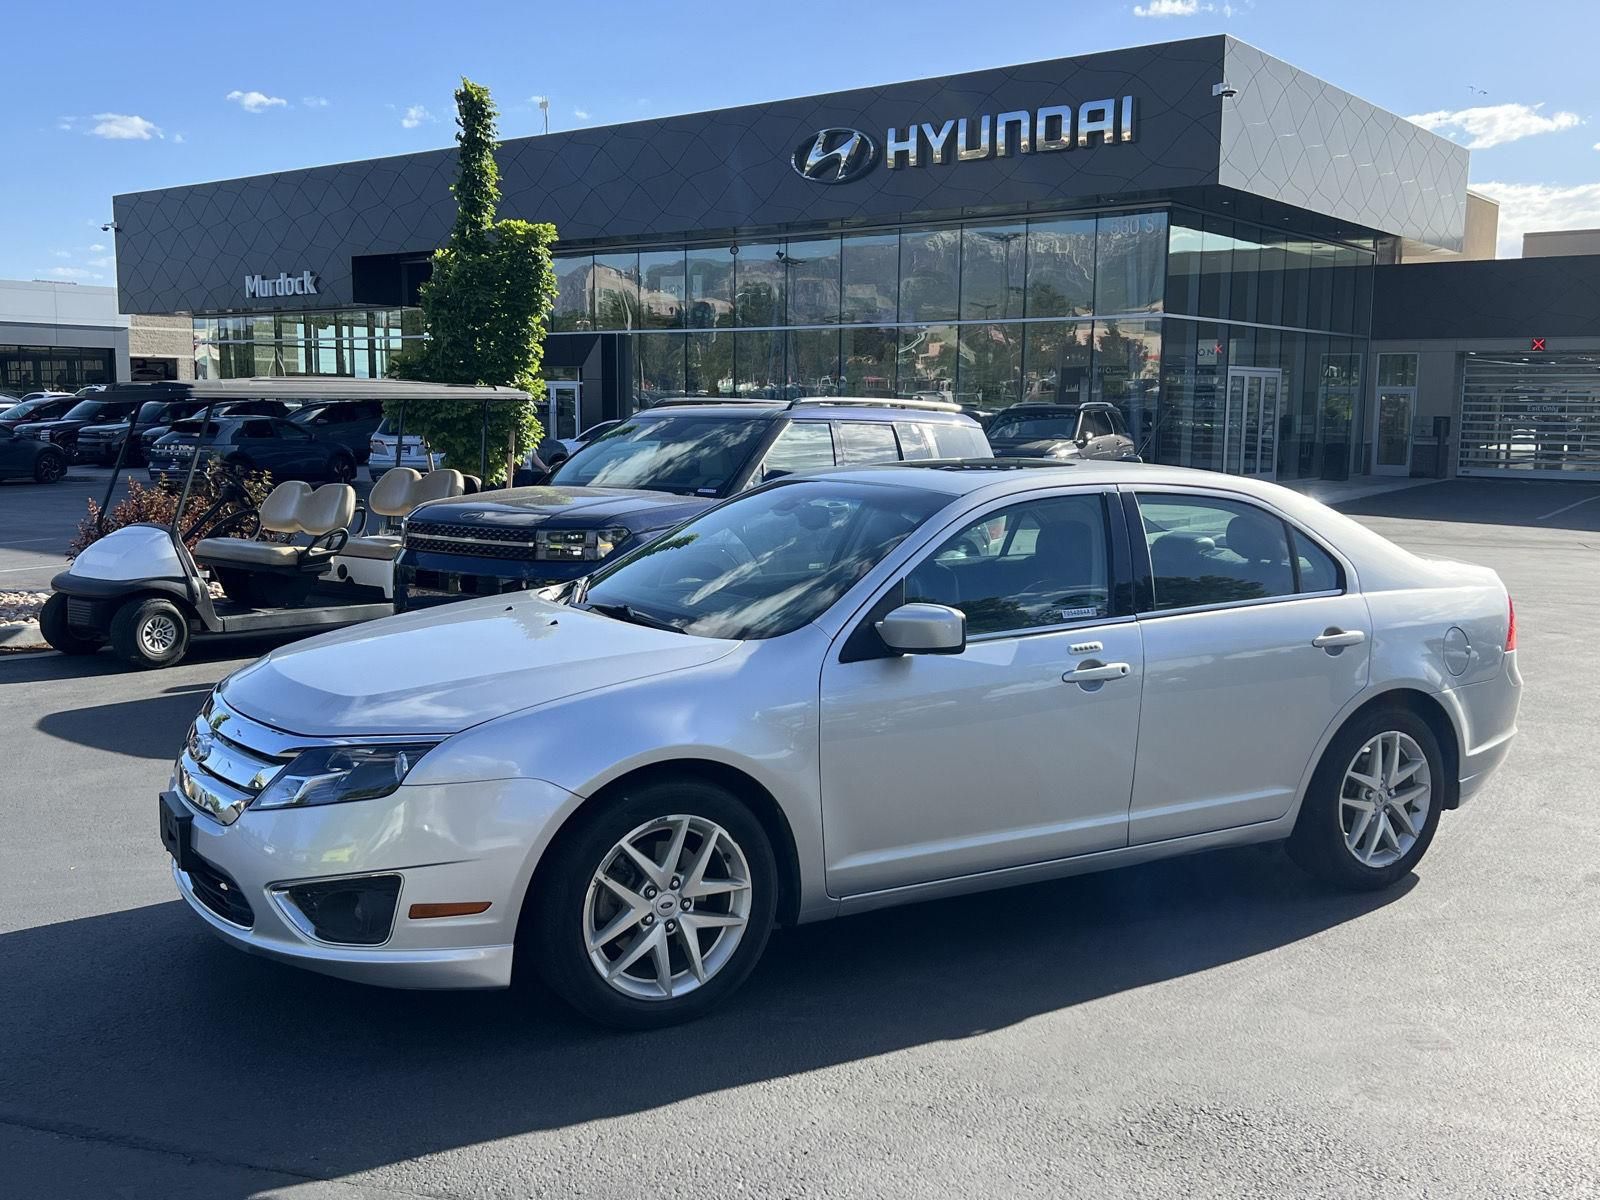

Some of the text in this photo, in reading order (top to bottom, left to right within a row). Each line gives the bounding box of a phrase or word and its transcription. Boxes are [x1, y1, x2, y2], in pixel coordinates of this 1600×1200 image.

[886, 95, 1133, 169] HYUNDAI
[1145, 216, 1155, 234] S
[244, 270, 318, 298] Murdock
